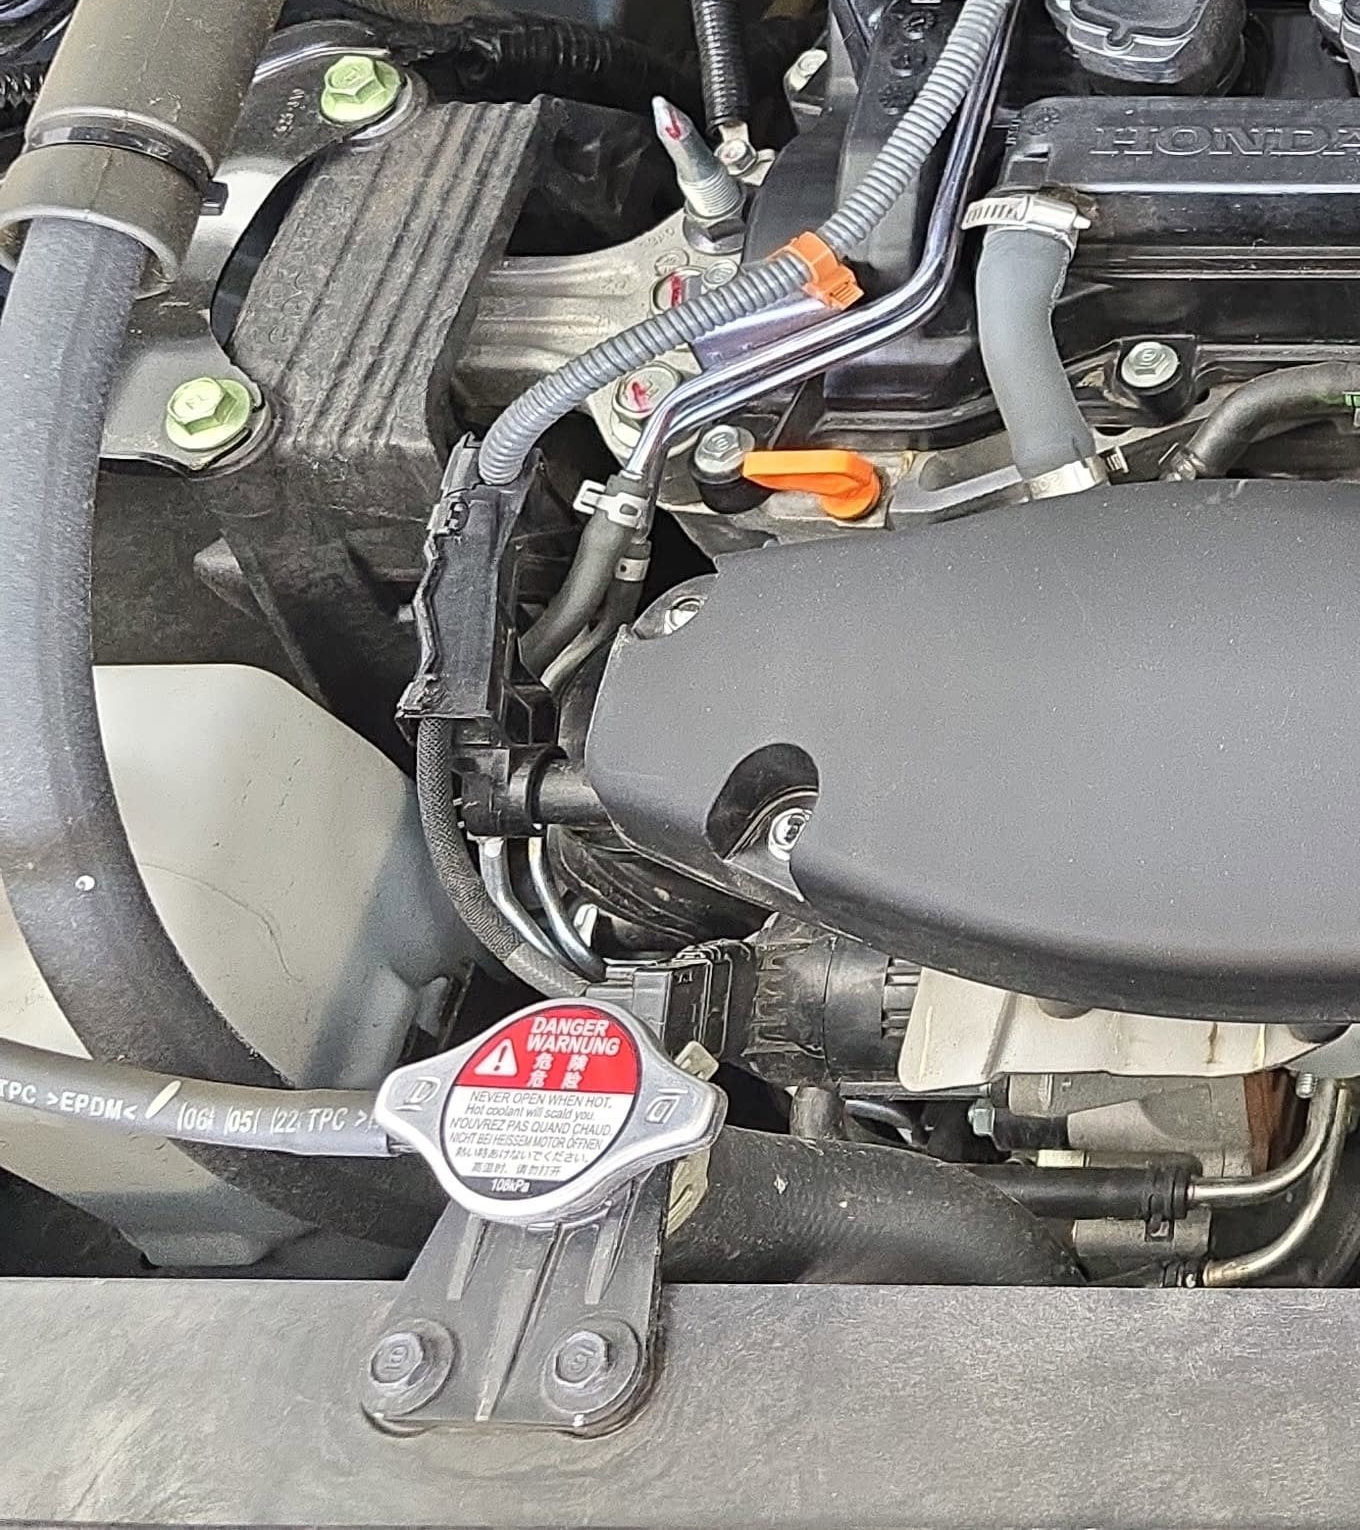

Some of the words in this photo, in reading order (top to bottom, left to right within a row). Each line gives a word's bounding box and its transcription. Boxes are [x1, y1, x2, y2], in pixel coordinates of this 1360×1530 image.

[532, 1017, 610, 1036] DANGER
[526, 1034, 621, 1056] WARNUNG
[46, 1091, 138, 1122] >EPDM<
[469, 1090, 510, 1104] NEVER
[512, 1092, 544, 1106] OPEN
[548, 1093, 584, 1107] WHEN
[585, 1095, 613, 1110] HOT.
[307, 1108, 349, 1133] TPC
[464, 1103, 485, 1116] Hot
[486, 1105, 524, 1117] coolant
[524, 1106, 544, 1119] will
[544, 1107, 573, 1120] scald
[450, 1116, 505, 1132] N'OUVREZ
[506, 1119, 530, 1133] PAS
[531, 1120, 570, 1135] QUAND
[450, 1131, 476, 1145] NICHT
[476, 1132, 492, 1145] BEI
[533, 1135, 566, 1149] MOTOR
